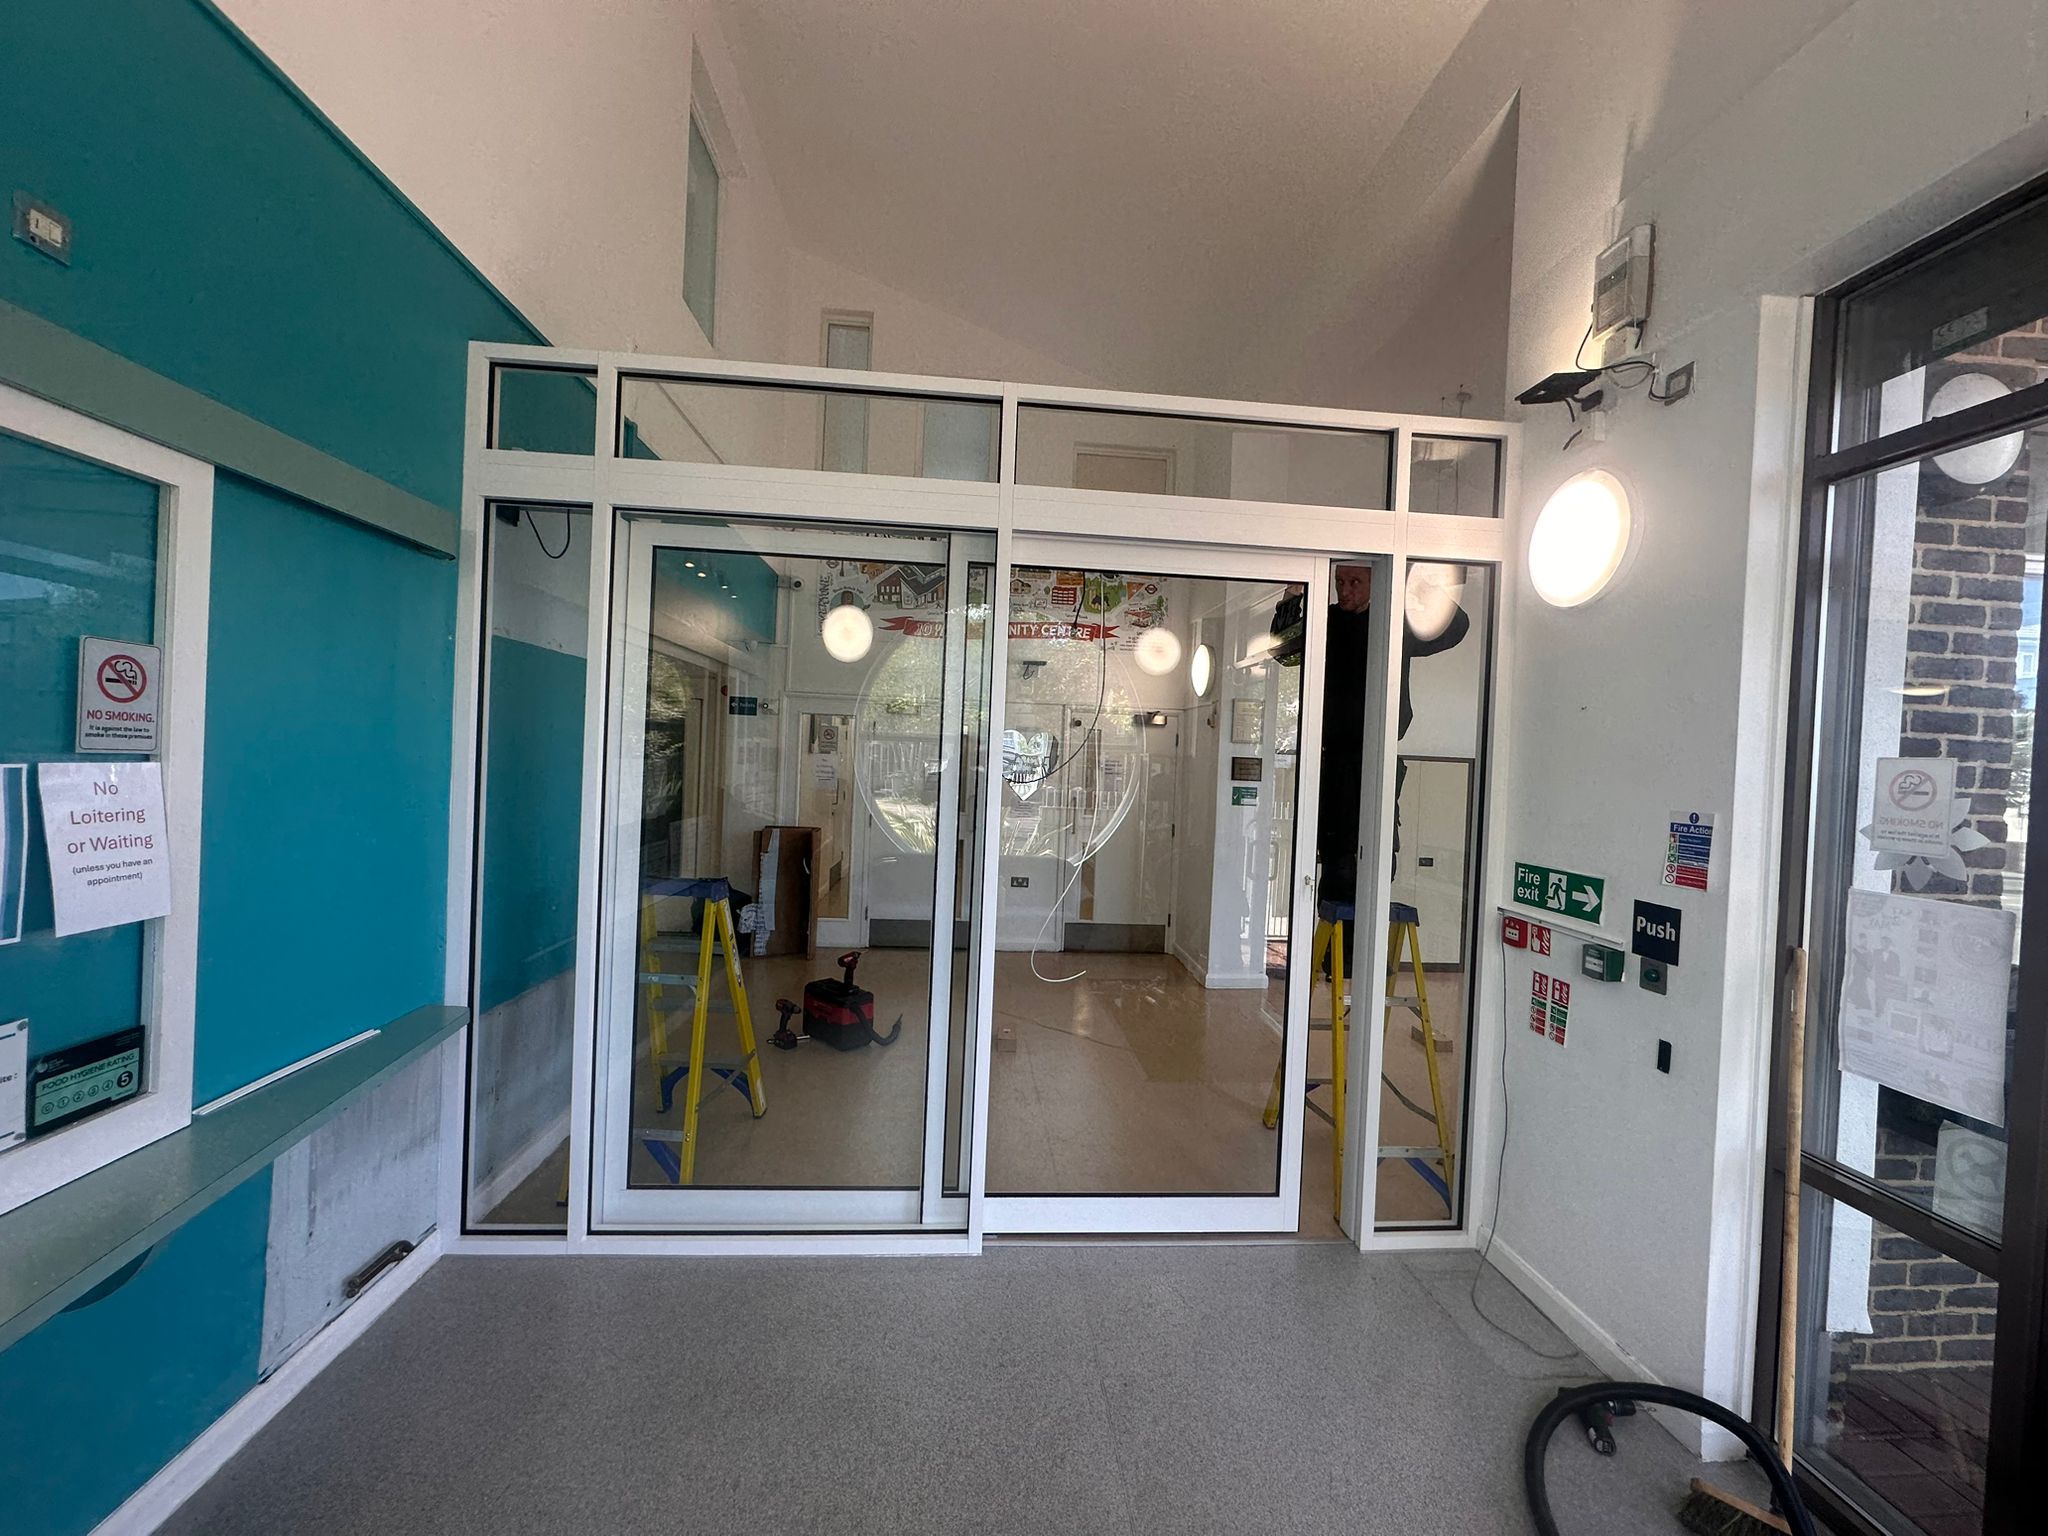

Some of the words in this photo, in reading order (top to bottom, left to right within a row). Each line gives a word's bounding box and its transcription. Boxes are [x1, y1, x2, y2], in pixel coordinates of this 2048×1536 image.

[86, 709, 103, 721] NO
[101, 725, 122, 733] against
[93, 781, 119, 796] No
[70, 807, 146, 825] Loitering
[1673, 823, 1688, 833] Fire
[67, 841, 86, 854] or
[89, 834, 154, 852] Waiting
[72, 863, 104, 876] (unless
[105, 862, 121, 872] you
[122, 859, 142, 868] have
[143, 858, 153, 866] an
[87, 871, 143, 886] appointment)
[1517, 867, 1541, 885] Fire
[1517, 885, 1539, 902] exit
[1636, 915, 1676, 942] Push
[42, 1076, 69, 1091] FOOD
[70, 1063, 106, 1080] HYGIENE
[107, 1053, 135, 1068] RATING
[121, 1072, 130, 1086] 5
